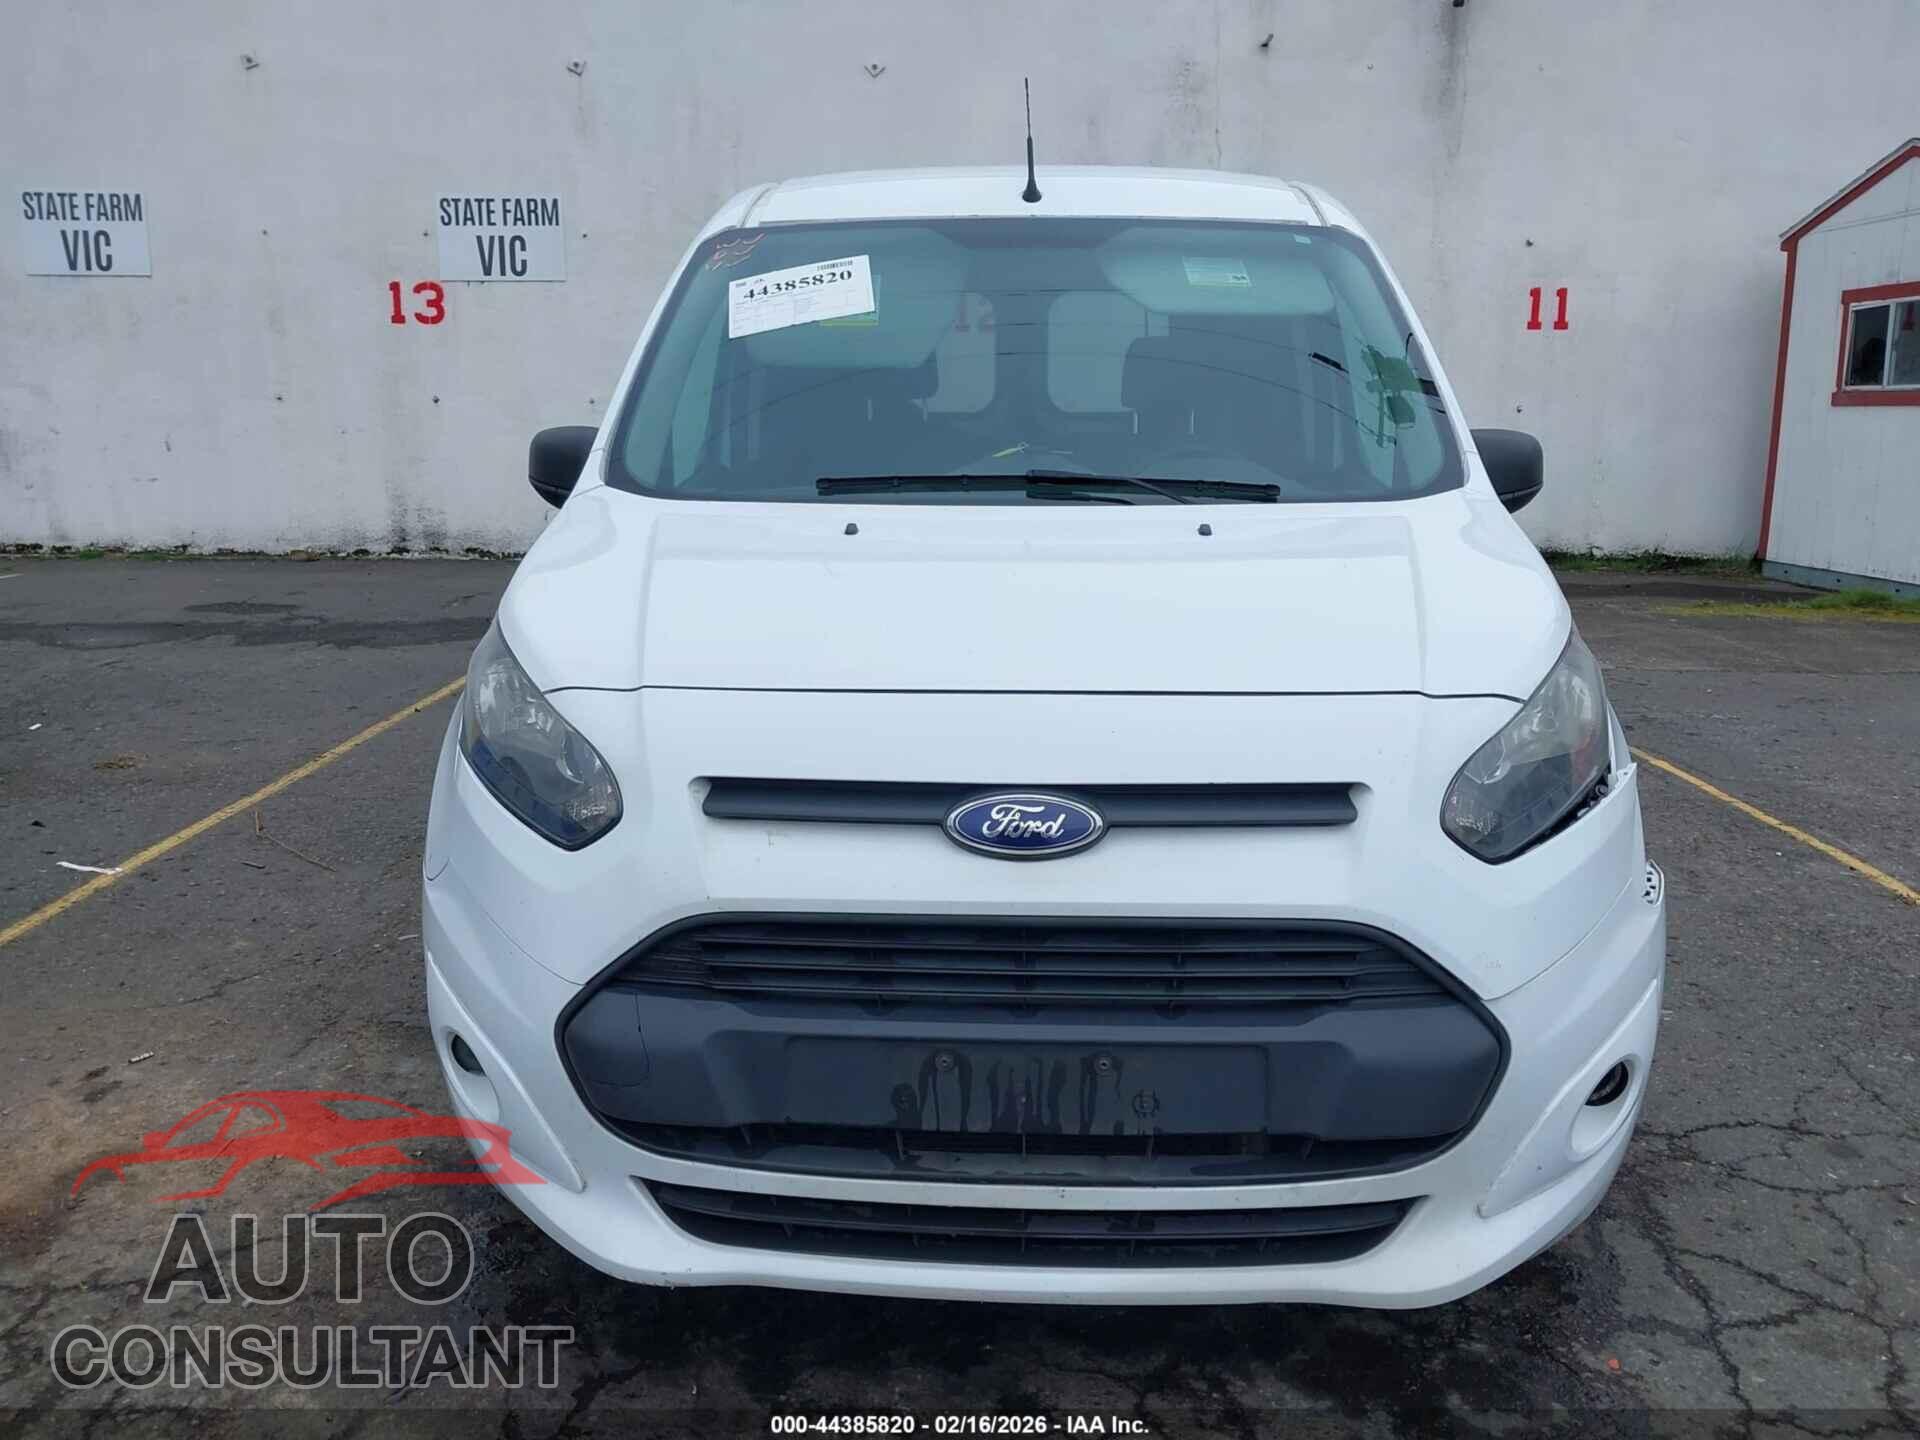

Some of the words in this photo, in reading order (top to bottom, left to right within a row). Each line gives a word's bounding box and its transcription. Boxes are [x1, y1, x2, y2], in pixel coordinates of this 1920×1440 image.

[22, 191, 80, 221] STATE
[84, 193, 143, 221] FARM
[439, 197, 497, 226] STATE
[501, 198, 560, 226] FARM
[60, 229, 113, 272] VIC
[476, 234, 528, 277] VIC
[389, 281, 446, 325] 13
[743, 270, 852, 302] 44385820
[1527, 287, 1569, 330] 11
[982, 804, 1066, 838] Ford
